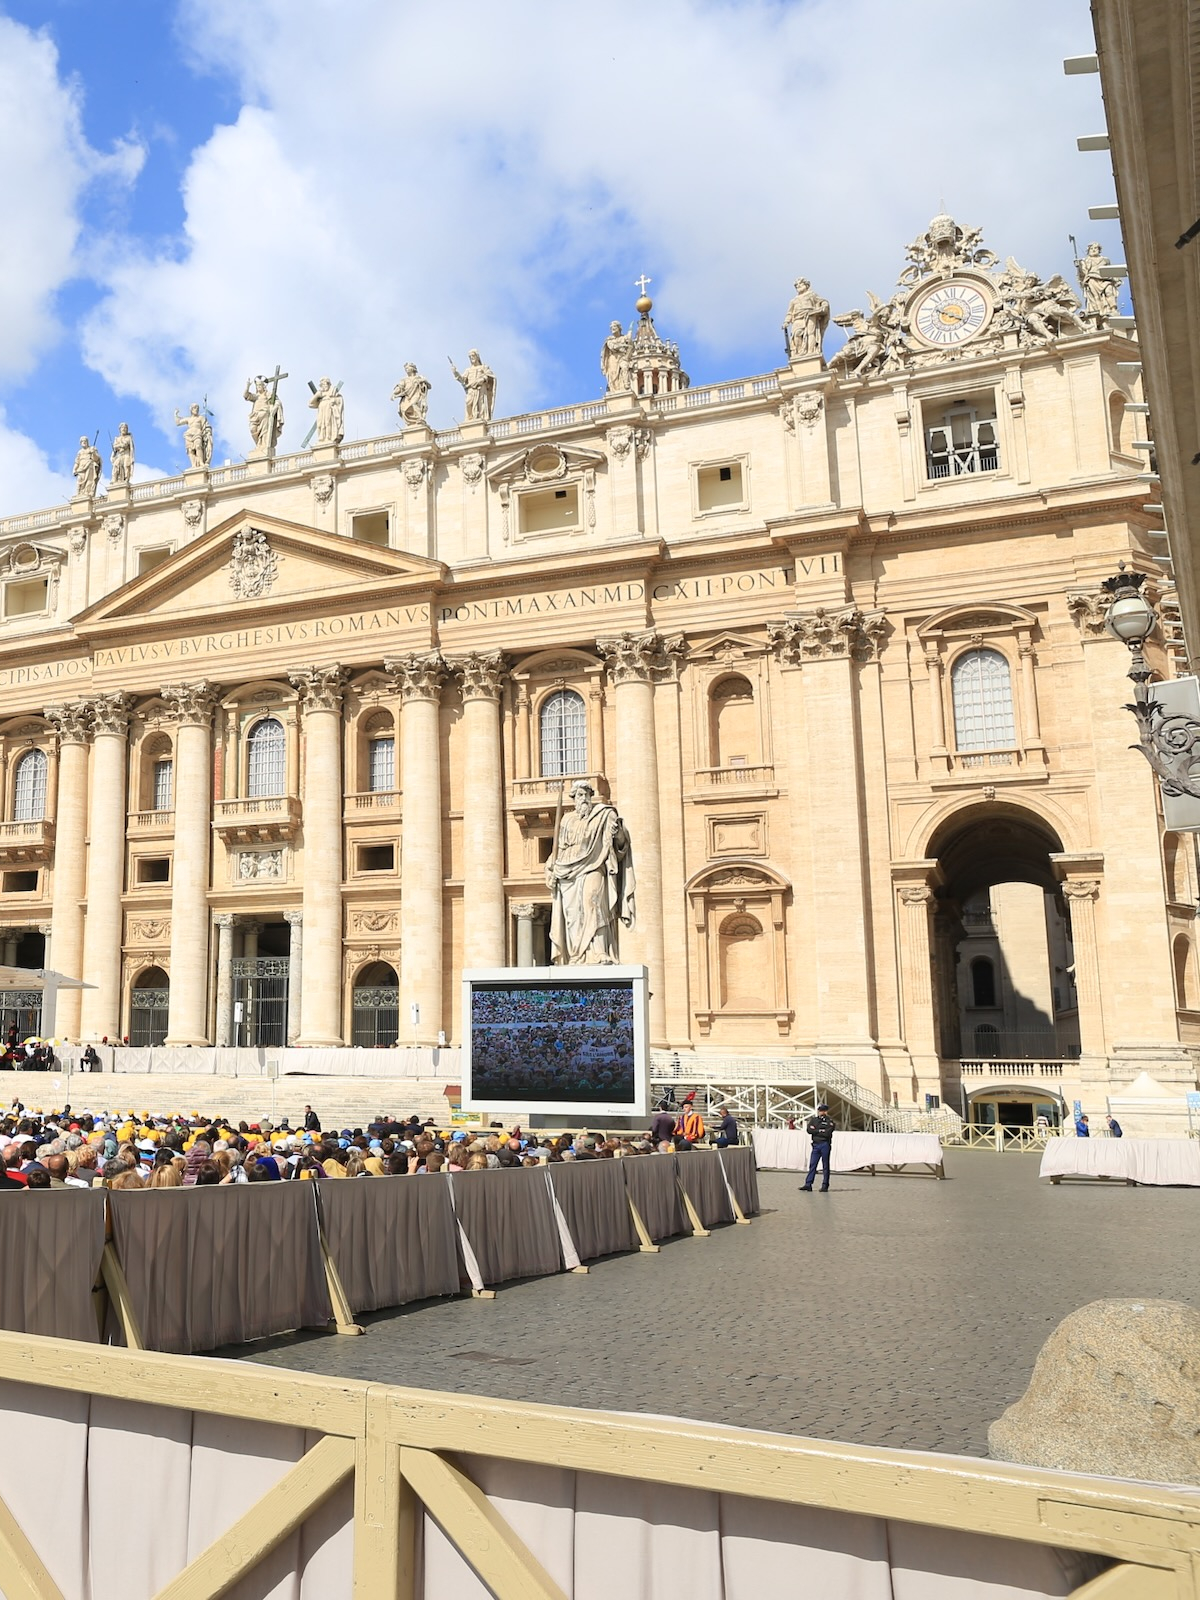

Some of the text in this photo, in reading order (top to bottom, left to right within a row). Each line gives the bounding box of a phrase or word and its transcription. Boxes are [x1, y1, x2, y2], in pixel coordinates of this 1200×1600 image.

[95, 645, 159, 667] PAVLVS
[180, 624, 307, 655] BVRGHESIVS
[315, 605, 429, 637] ROMANVS
[442, 600, 504, 624] PONT
[720, 568, 794, 594] PONT
[799, 555, 841, 576] VII
